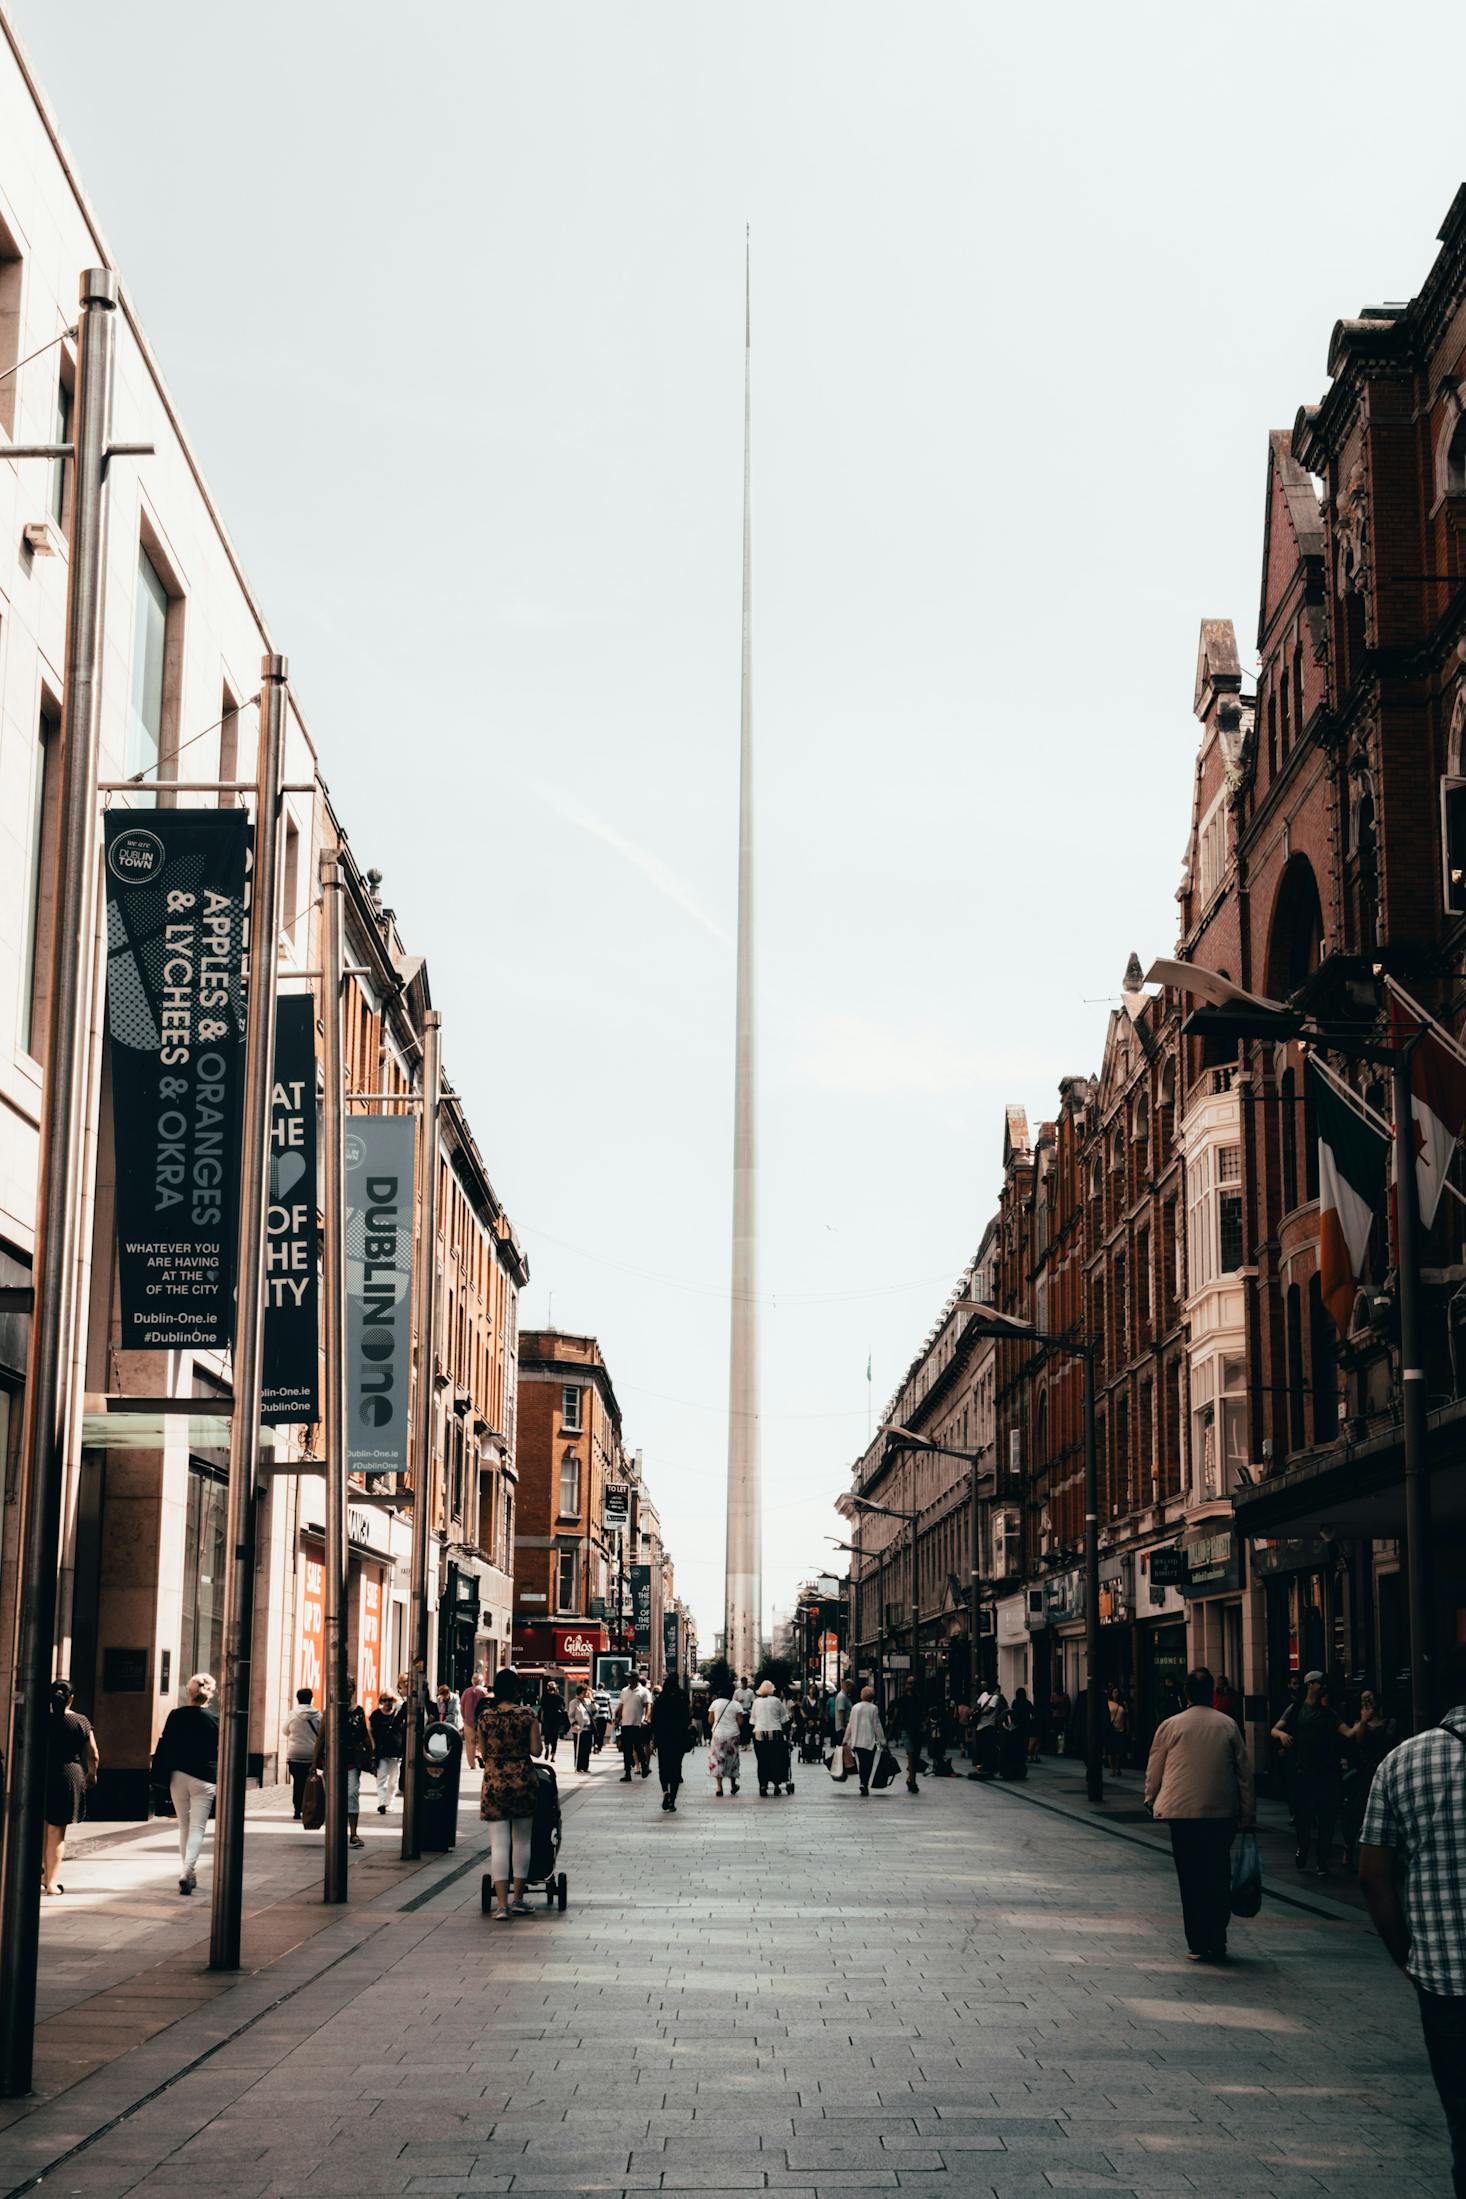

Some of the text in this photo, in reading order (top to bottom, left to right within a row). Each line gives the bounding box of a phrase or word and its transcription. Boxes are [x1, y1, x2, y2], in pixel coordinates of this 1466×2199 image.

[119, 849, 154, 861] DUBLIN
[119, 857, 153, 870] TOWN
[155, 889, 196, 1212] & LYCHEES & OKRA
[191, 889, 232, 1226] APPLES & ORANGES
[271, 1082, 306, 1110] AT
[270, 1118, 305, 1146] HE
[267, 1205, 308, 1235] OF
[126, 1243, 220, 1253] WHATEVER YOU
[267, 1241, 308, 1271] HE
[147, 1257, 219, 1267] ARE HAVING
[162, 1271, 203, 1281] AT THE
[146, 1285, 219, 1295] OF THE CITY
[265, 1278, 310, 1307] ITY
[134, 1312, 218, 1324] Dublin-One.ie
[144, 1331, 217, 1342] #DublinOne
[260, 1387, 311, 1397] lin-One.ie
[260, 1402, 311, 1412] DublinOne
[607, 1485, 617, 1493] TO
[307, 1561, 322, 1595] SALE
[367, 1581, 378, 1610] SALE
[304, 1600, 321, 1634] UP TO
[302, 1638, 321, 1691] 70%
